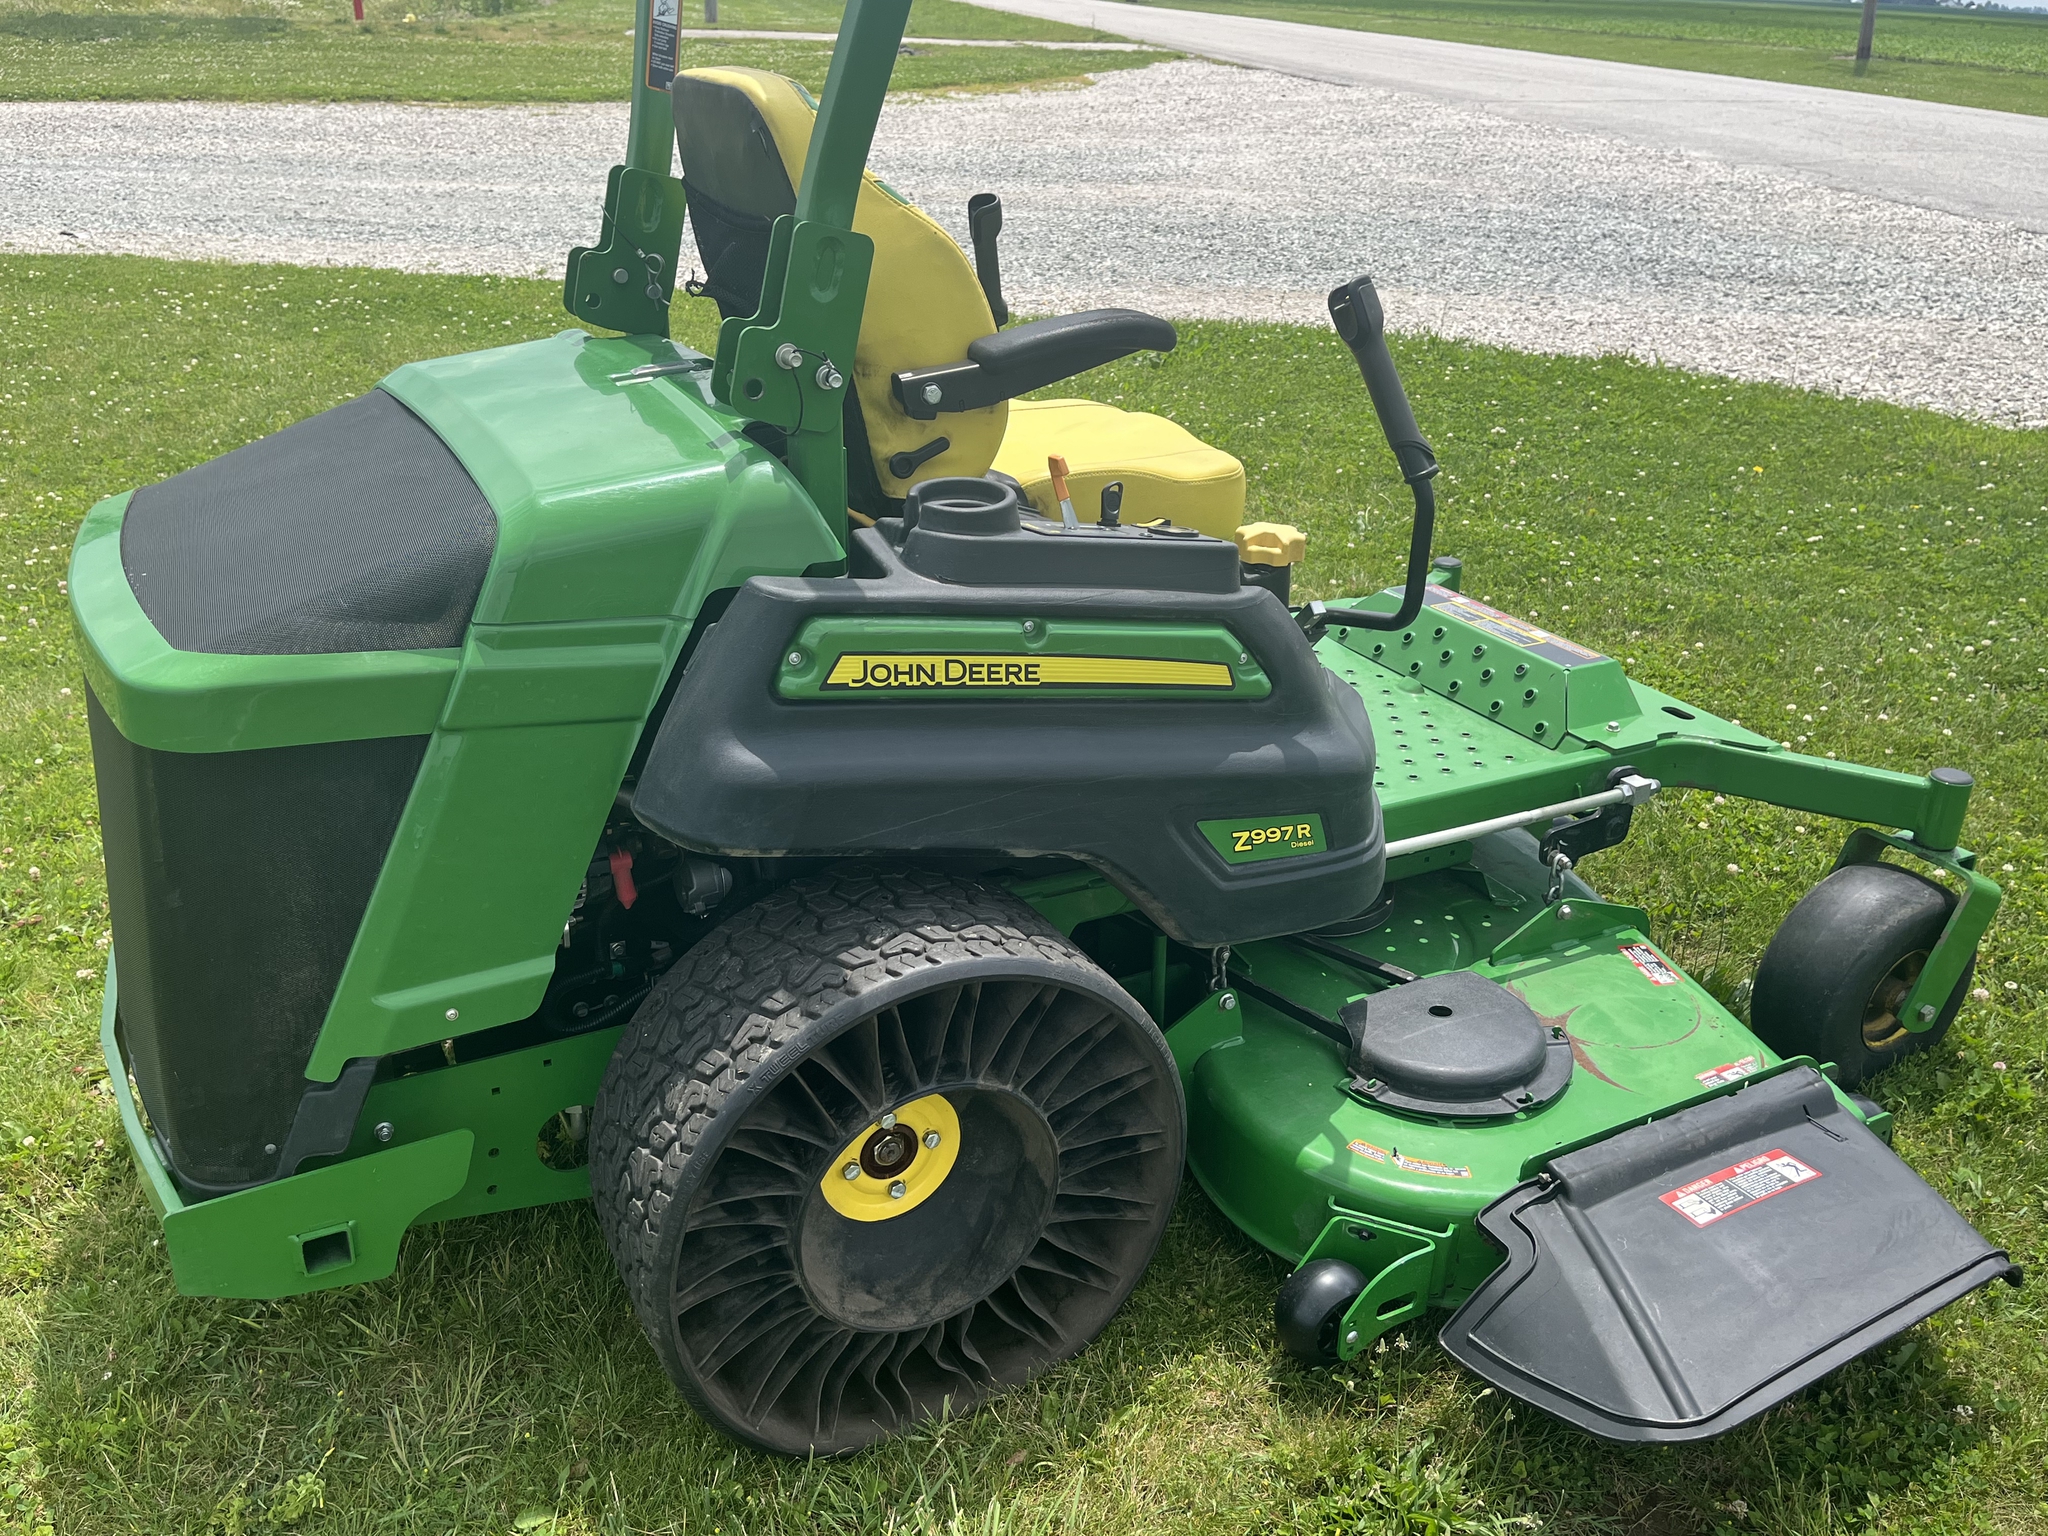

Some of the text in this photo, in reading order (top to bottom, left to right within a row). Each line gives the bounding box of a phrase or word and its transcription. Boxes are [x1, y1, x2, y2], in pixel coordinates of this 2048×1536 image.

[851, 659, 1041, 684] JOHN DEERE
[1290, 839, 1315, 849] Diesel
[759, 1042, 811, 1084] TWEEL
[806, 1013, 846, 1044] TURF
[1682, 1178, 1714, 1194] DANGER
